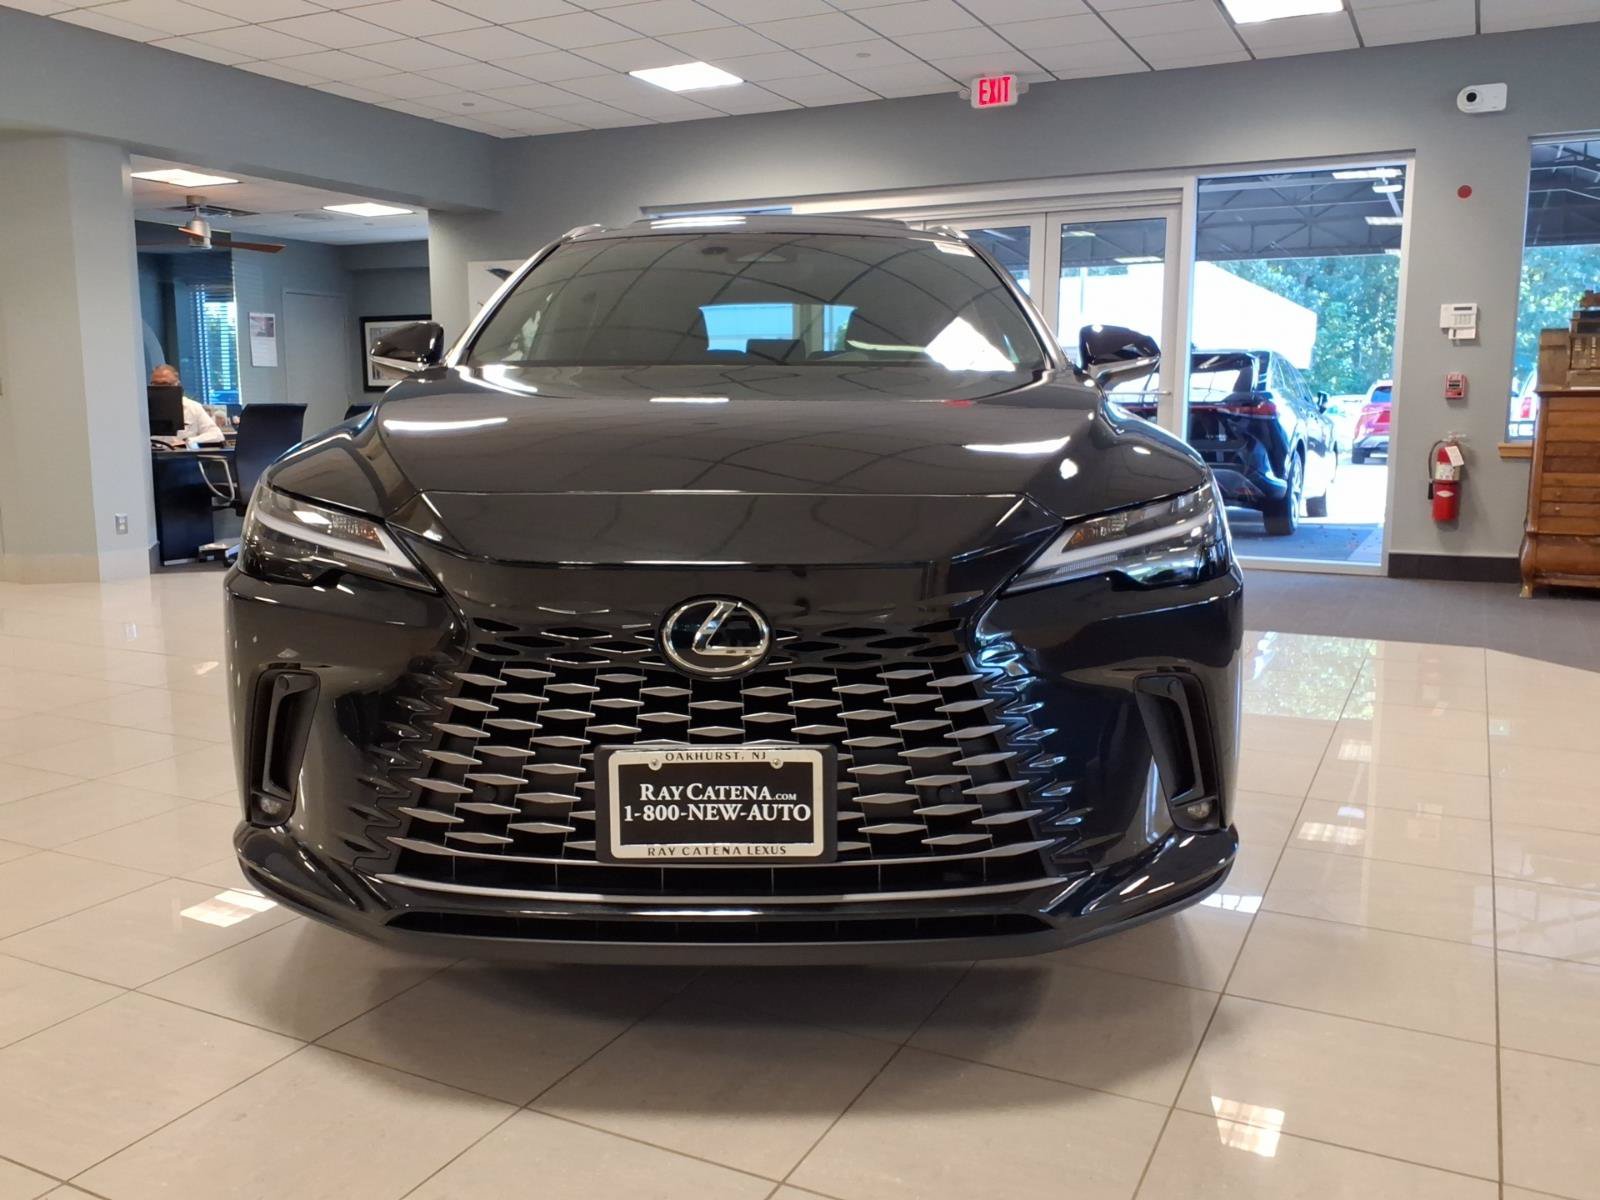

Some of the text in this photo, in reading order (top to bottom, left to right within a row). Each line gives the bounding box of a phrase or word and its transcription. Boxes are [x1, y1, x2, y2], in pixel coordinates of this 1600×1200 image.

[979, 76, 1011, 105] EXIT
[752, 751, 767, 760] NJ
[624, 803, 811, 822] 1-800-NEW-AUTO
[647, 845, 787, 856] RAY CATENA LEXUS
